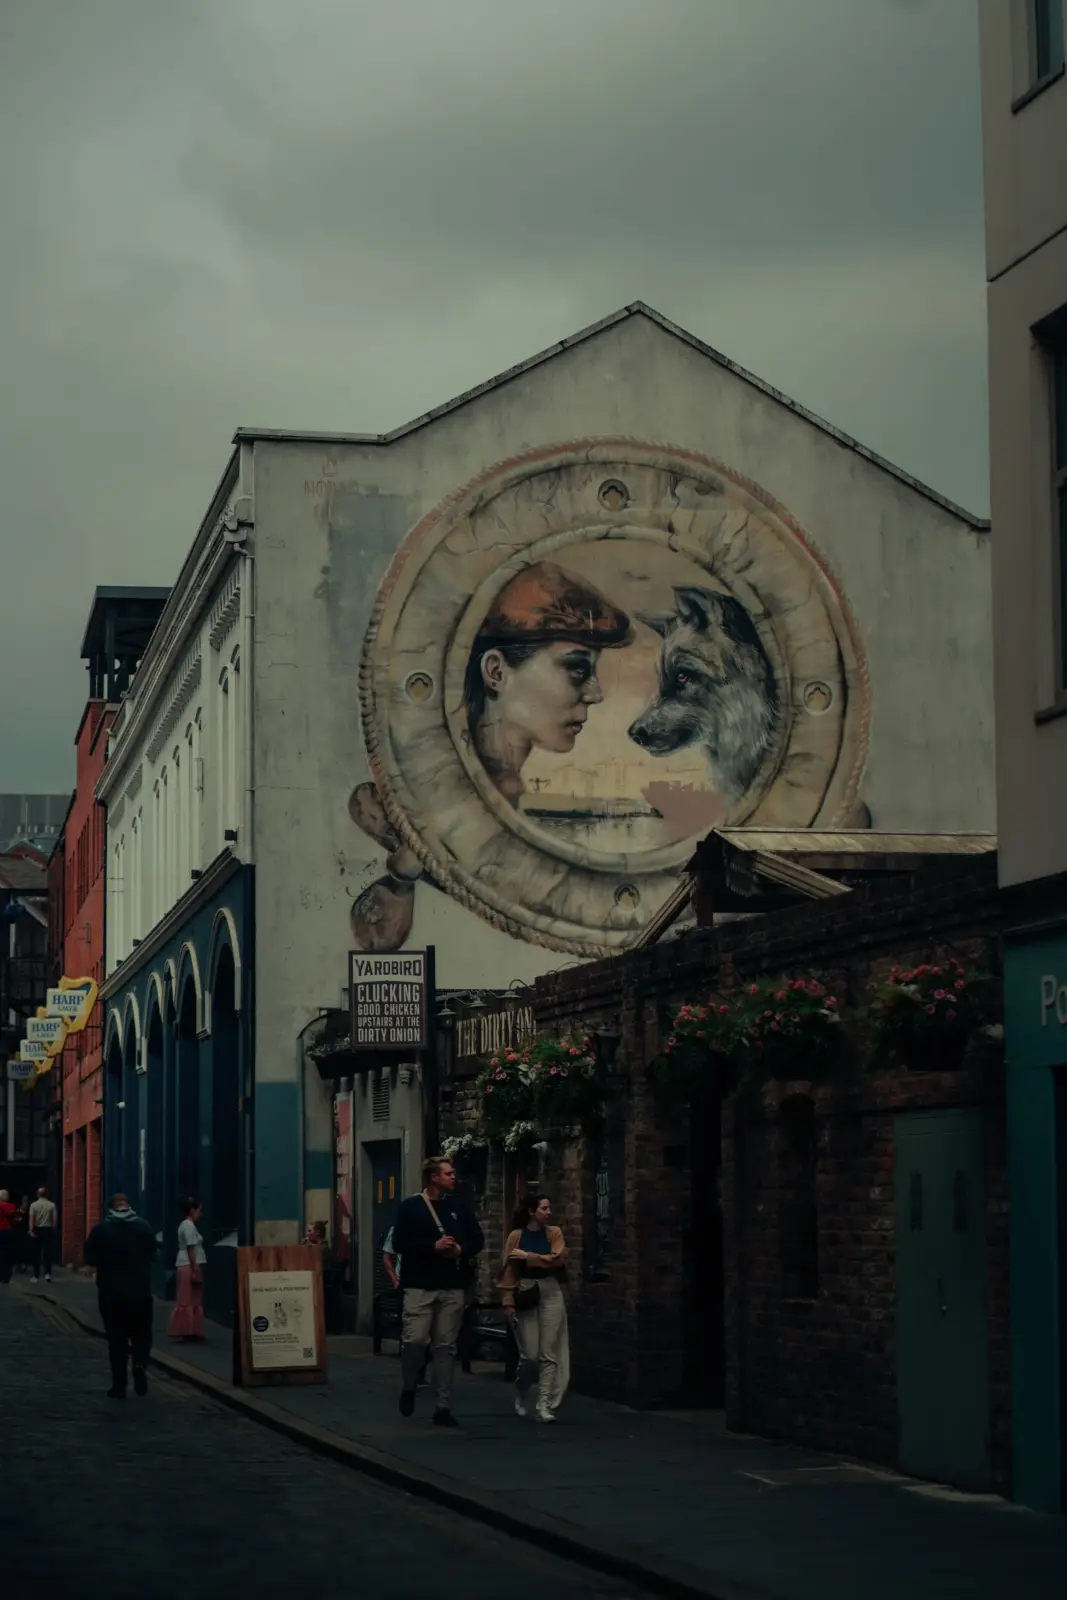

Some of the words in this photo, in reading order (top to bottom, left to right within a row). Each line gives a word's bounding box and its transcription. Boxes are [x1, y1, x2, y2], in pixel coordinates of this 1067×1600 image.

[355, 959, 422, 977] YARDBIRD
[52, 994, 84, 1005] HARP
[357, 983, 420, 1003] CLUCKING
[357, 1003, 381, 1016] GOOD
[384, 1003, 420, 1015] CHICKEN
[32, 1022, 60, 1032] HARP
[357, 1016, 393, 1027] UPSTAIRS
[395, 1016, 405, 1027] AT
[406, 1016, 420, 1026] THE
[357, 1028, 387, 1043] DIRTY
[389, 1027, 420, 1042] ONION
[456, 1018, 477, 1057] THE
[480, 1011, 515, 1054] DIRTY
[24, 1044, 44, 1053] HAR
